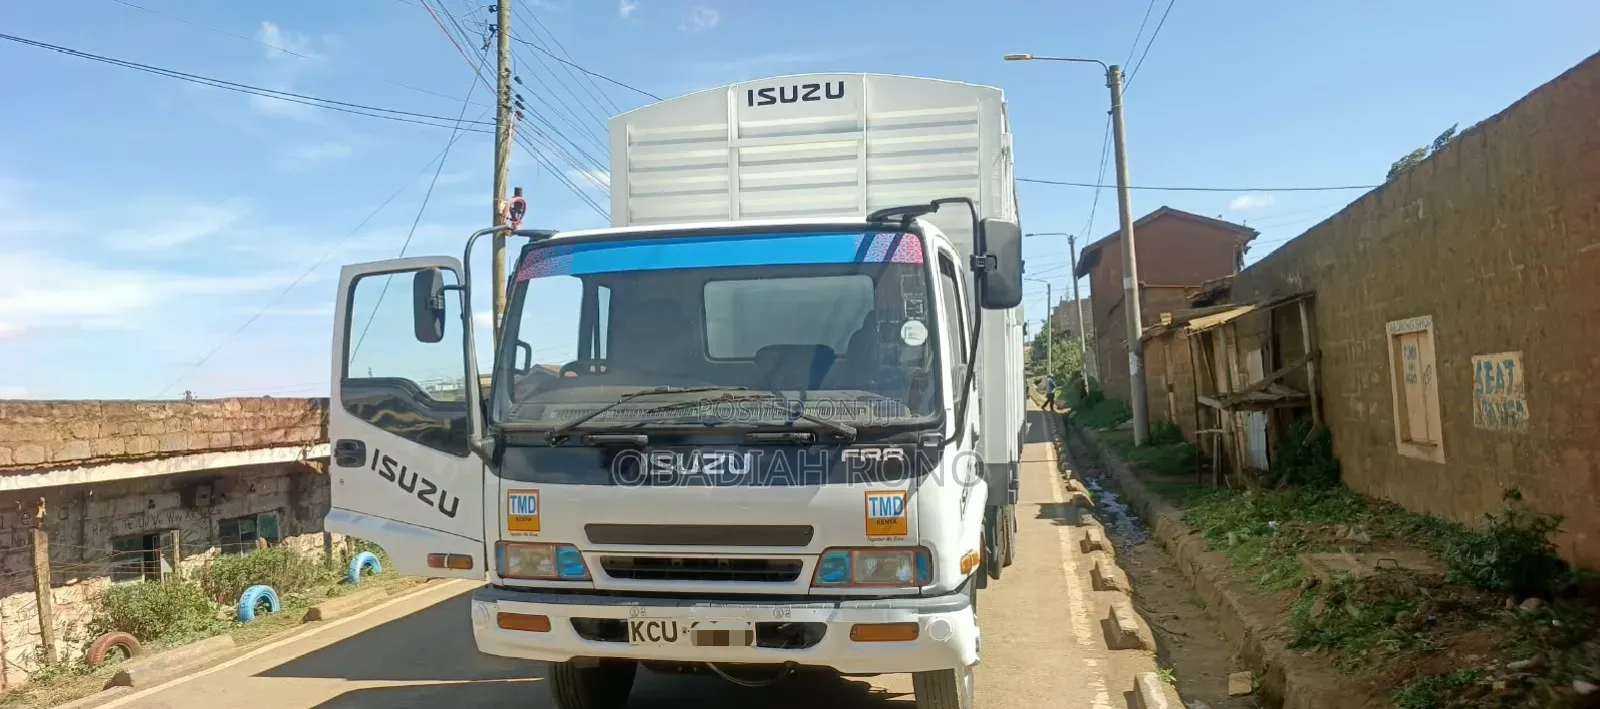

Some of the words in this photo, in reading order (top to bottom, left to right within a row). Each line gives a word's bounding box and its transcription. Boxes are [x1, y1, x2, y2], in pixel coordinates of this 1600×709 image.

[747, 81, 844, 106] ISUZU
[1475, 359, 1514, 397] SEAT
[640, 452, 751, 475] ISUZU
[841, 447, 904, 462] FRR
[371, 448, 460, 518] ISUZU
[510, 495, 536, 514] TMD
[868, 496, 904, 517] TMD
[630, 620, 678, 643] KCU
